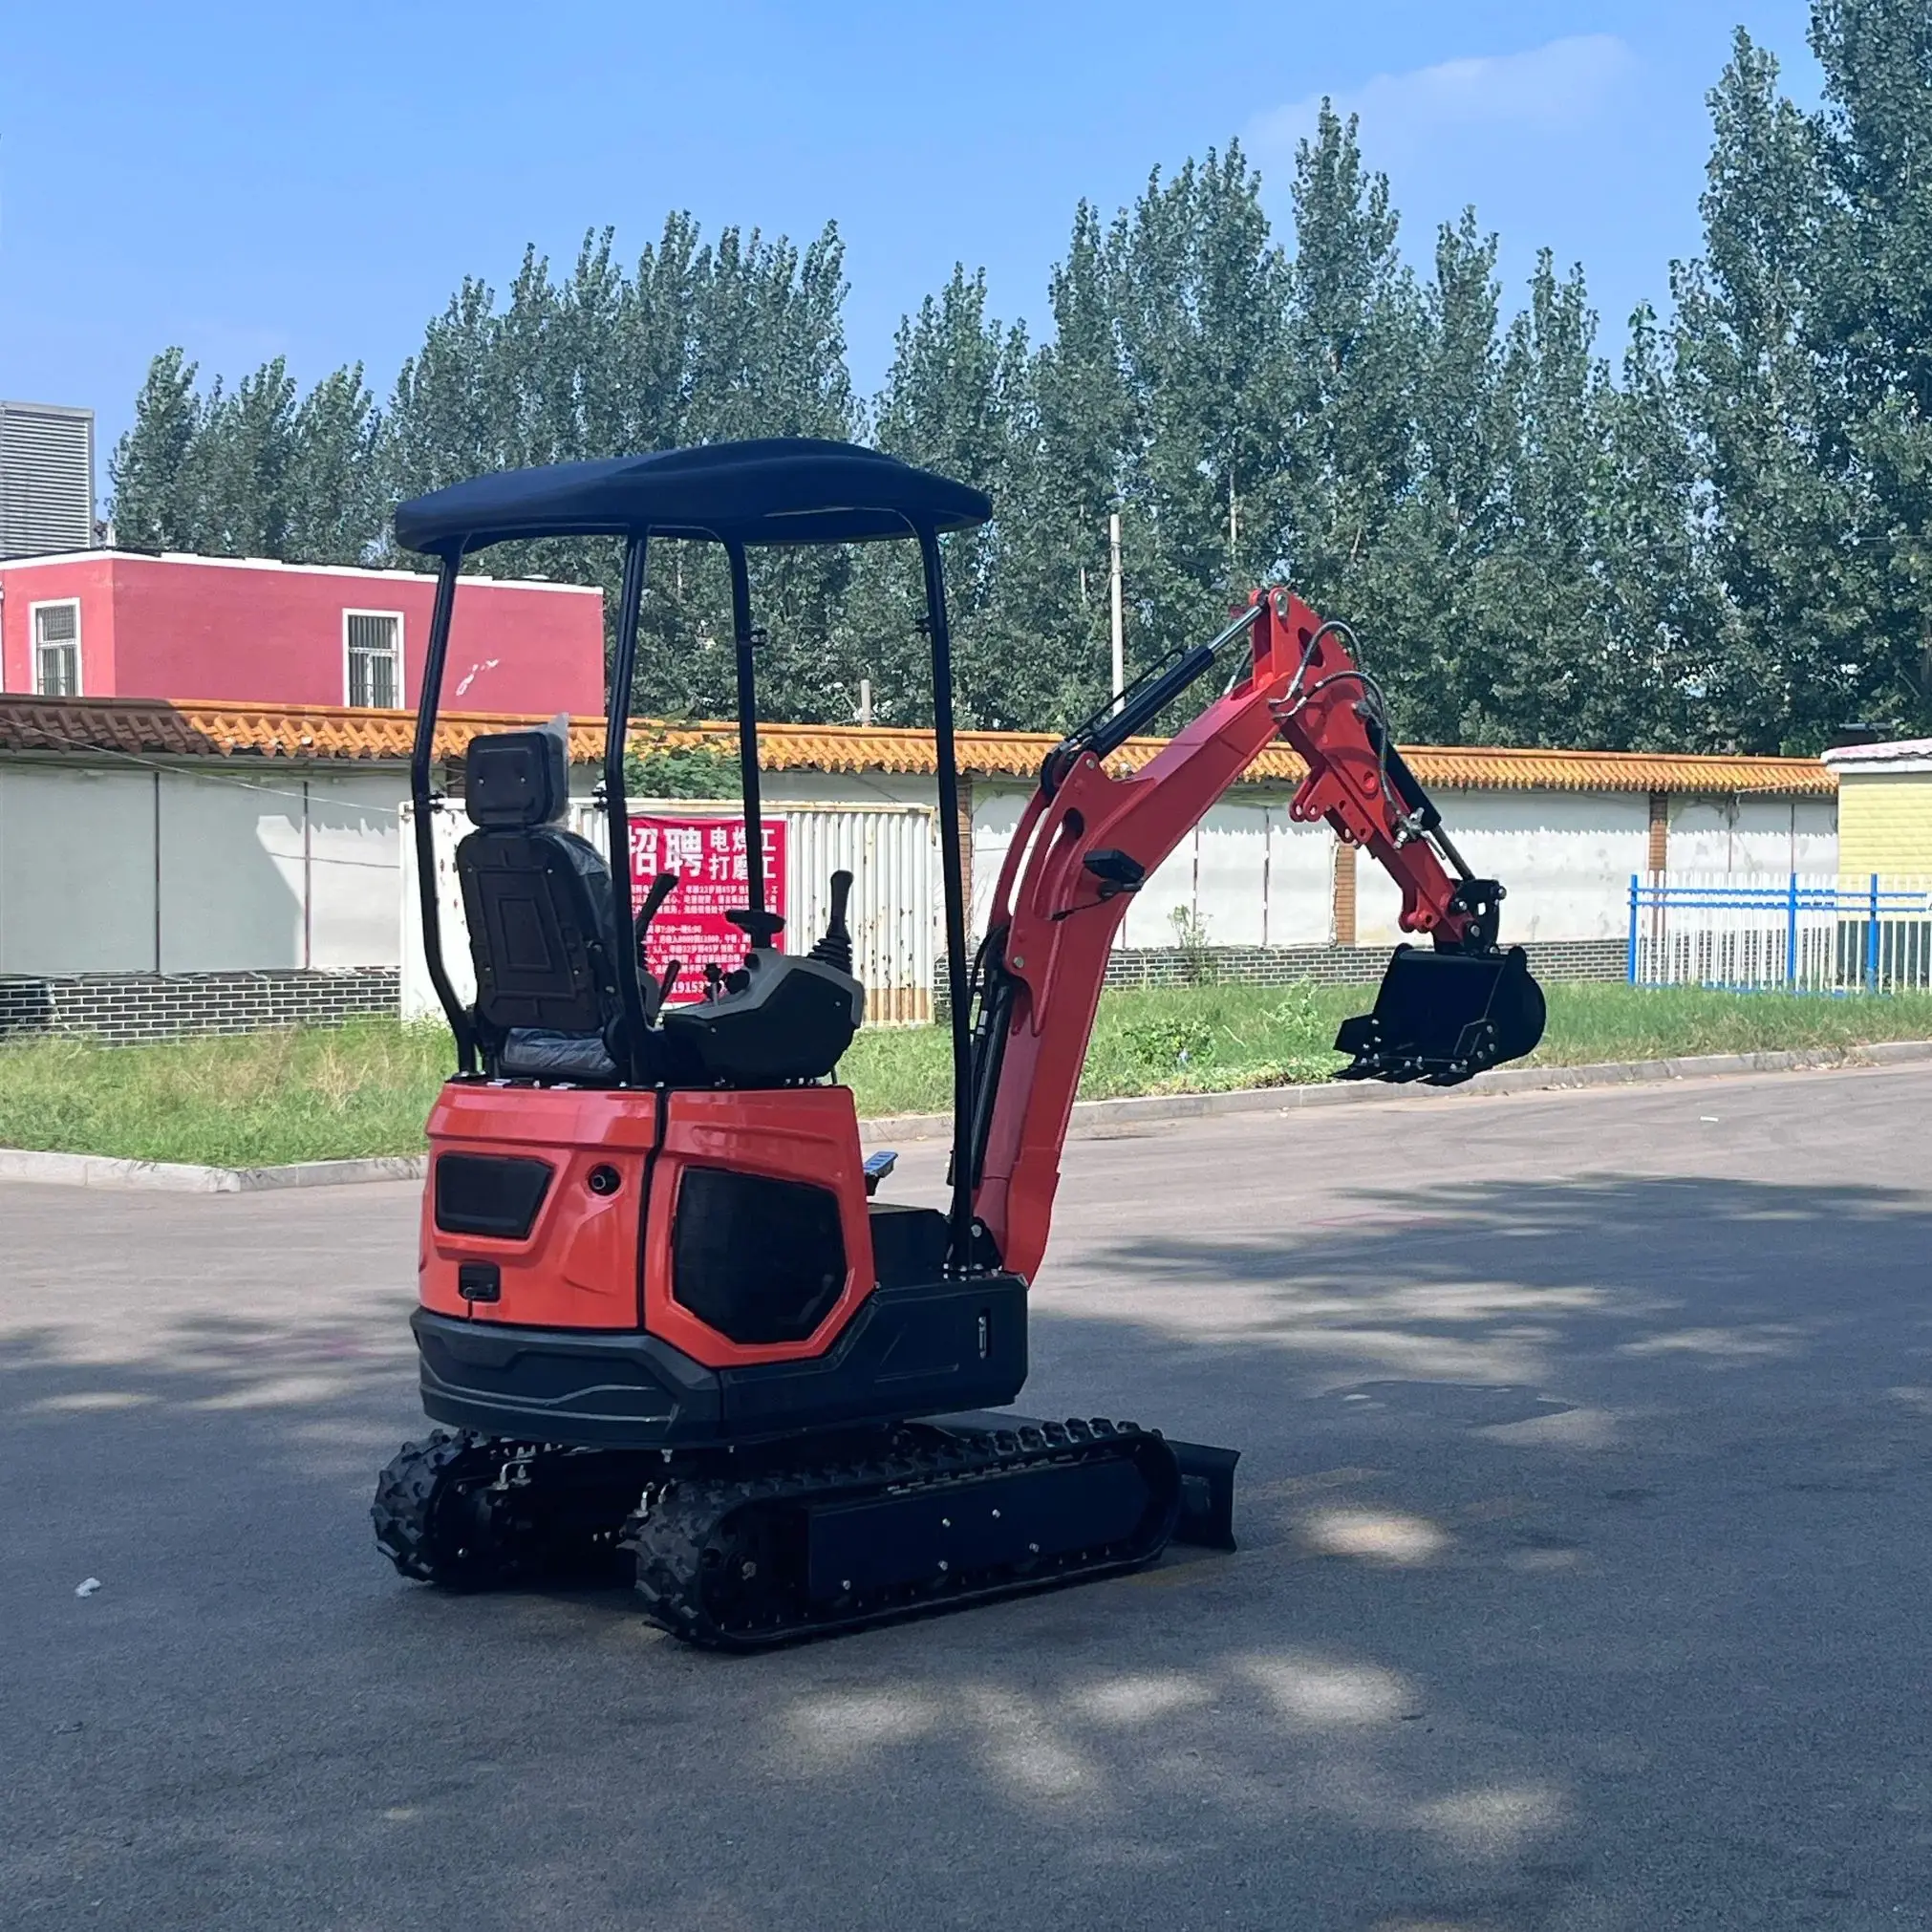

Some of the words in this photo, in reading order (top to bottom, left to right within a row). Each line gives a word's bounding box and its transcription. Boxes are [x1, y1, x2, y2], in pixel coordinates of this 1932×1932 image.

[629, 826, 703, 878] 招聘
[709, 853, 776, 881] 打磨工
